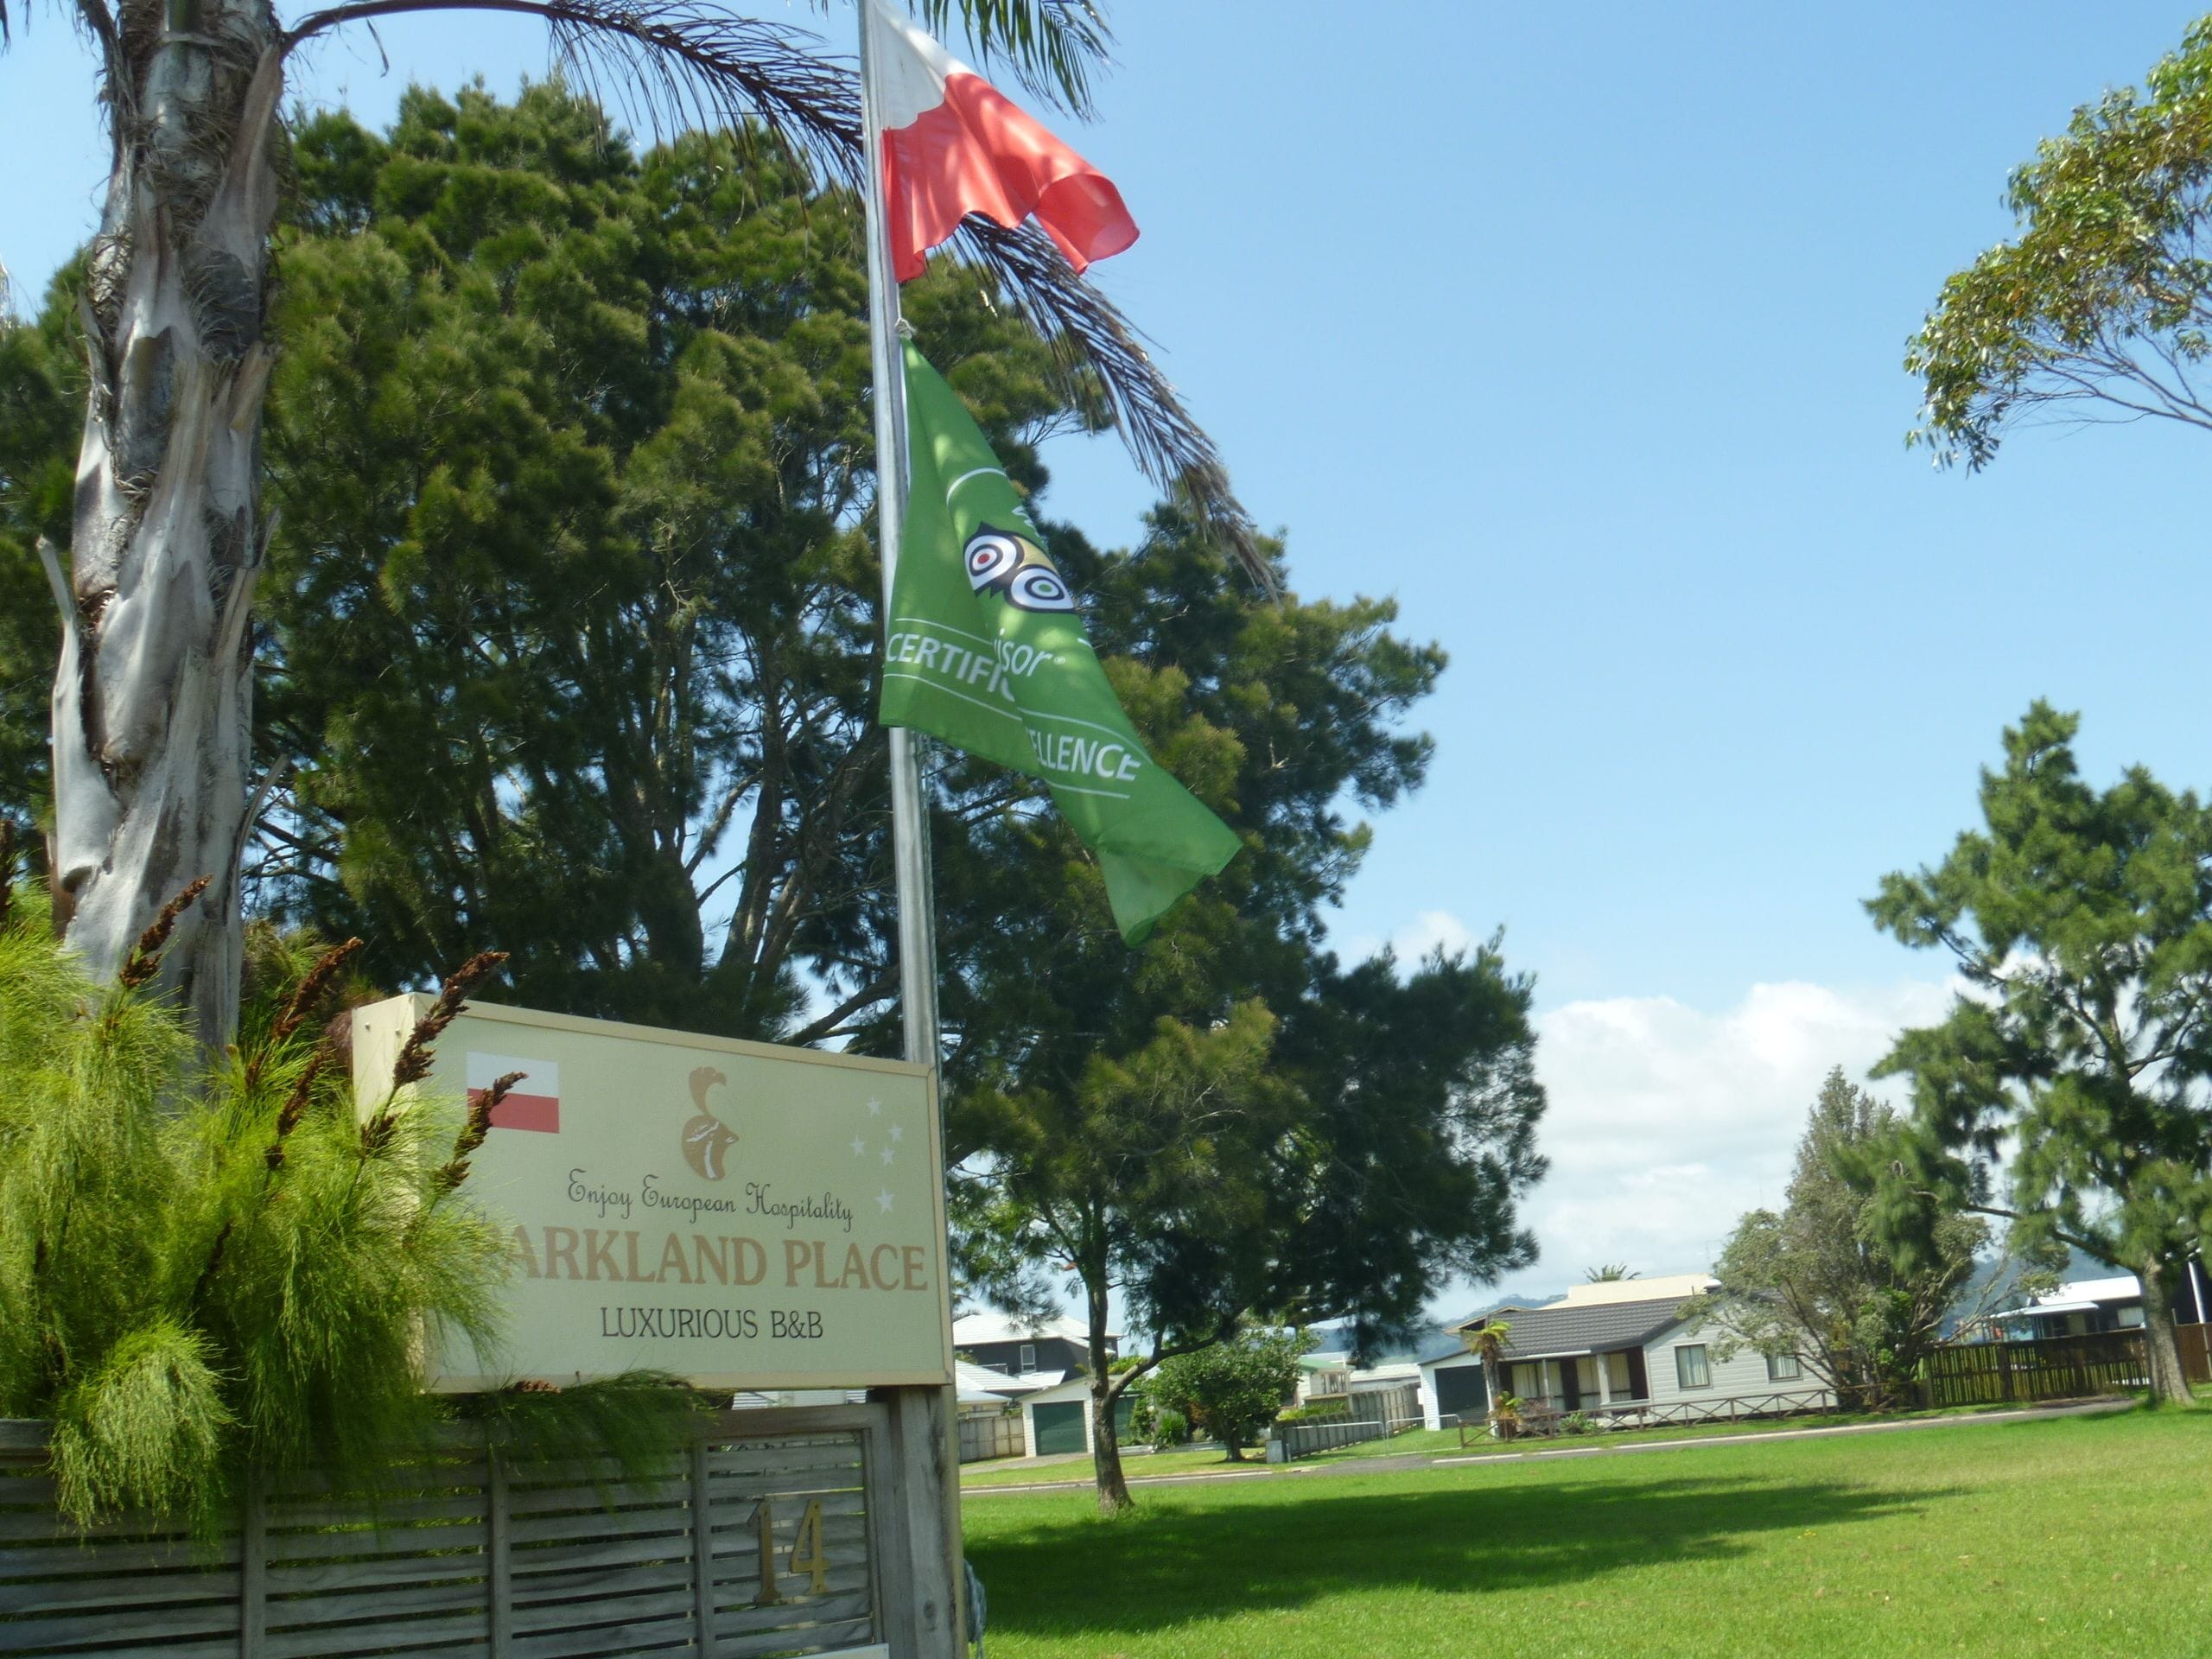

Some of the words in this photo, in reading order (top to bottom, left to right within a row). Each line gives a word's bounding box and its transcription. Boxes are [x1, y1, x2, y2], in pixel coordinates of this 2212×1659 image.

[568, 1168, 632, 1219] Enjoy
[642, 1174, 736, 1224] European
[746, 1182, 852, 1233] Hospitality
[486, 1225, 767, 1286] ARKLAND
[783, 1239, 928, 1291] PLACE
[601, 1307, 758, 1338] LUXURIOUS
[771, 1310, 823, 1338] B&B
[747, 1497, 831, 1605] 14
